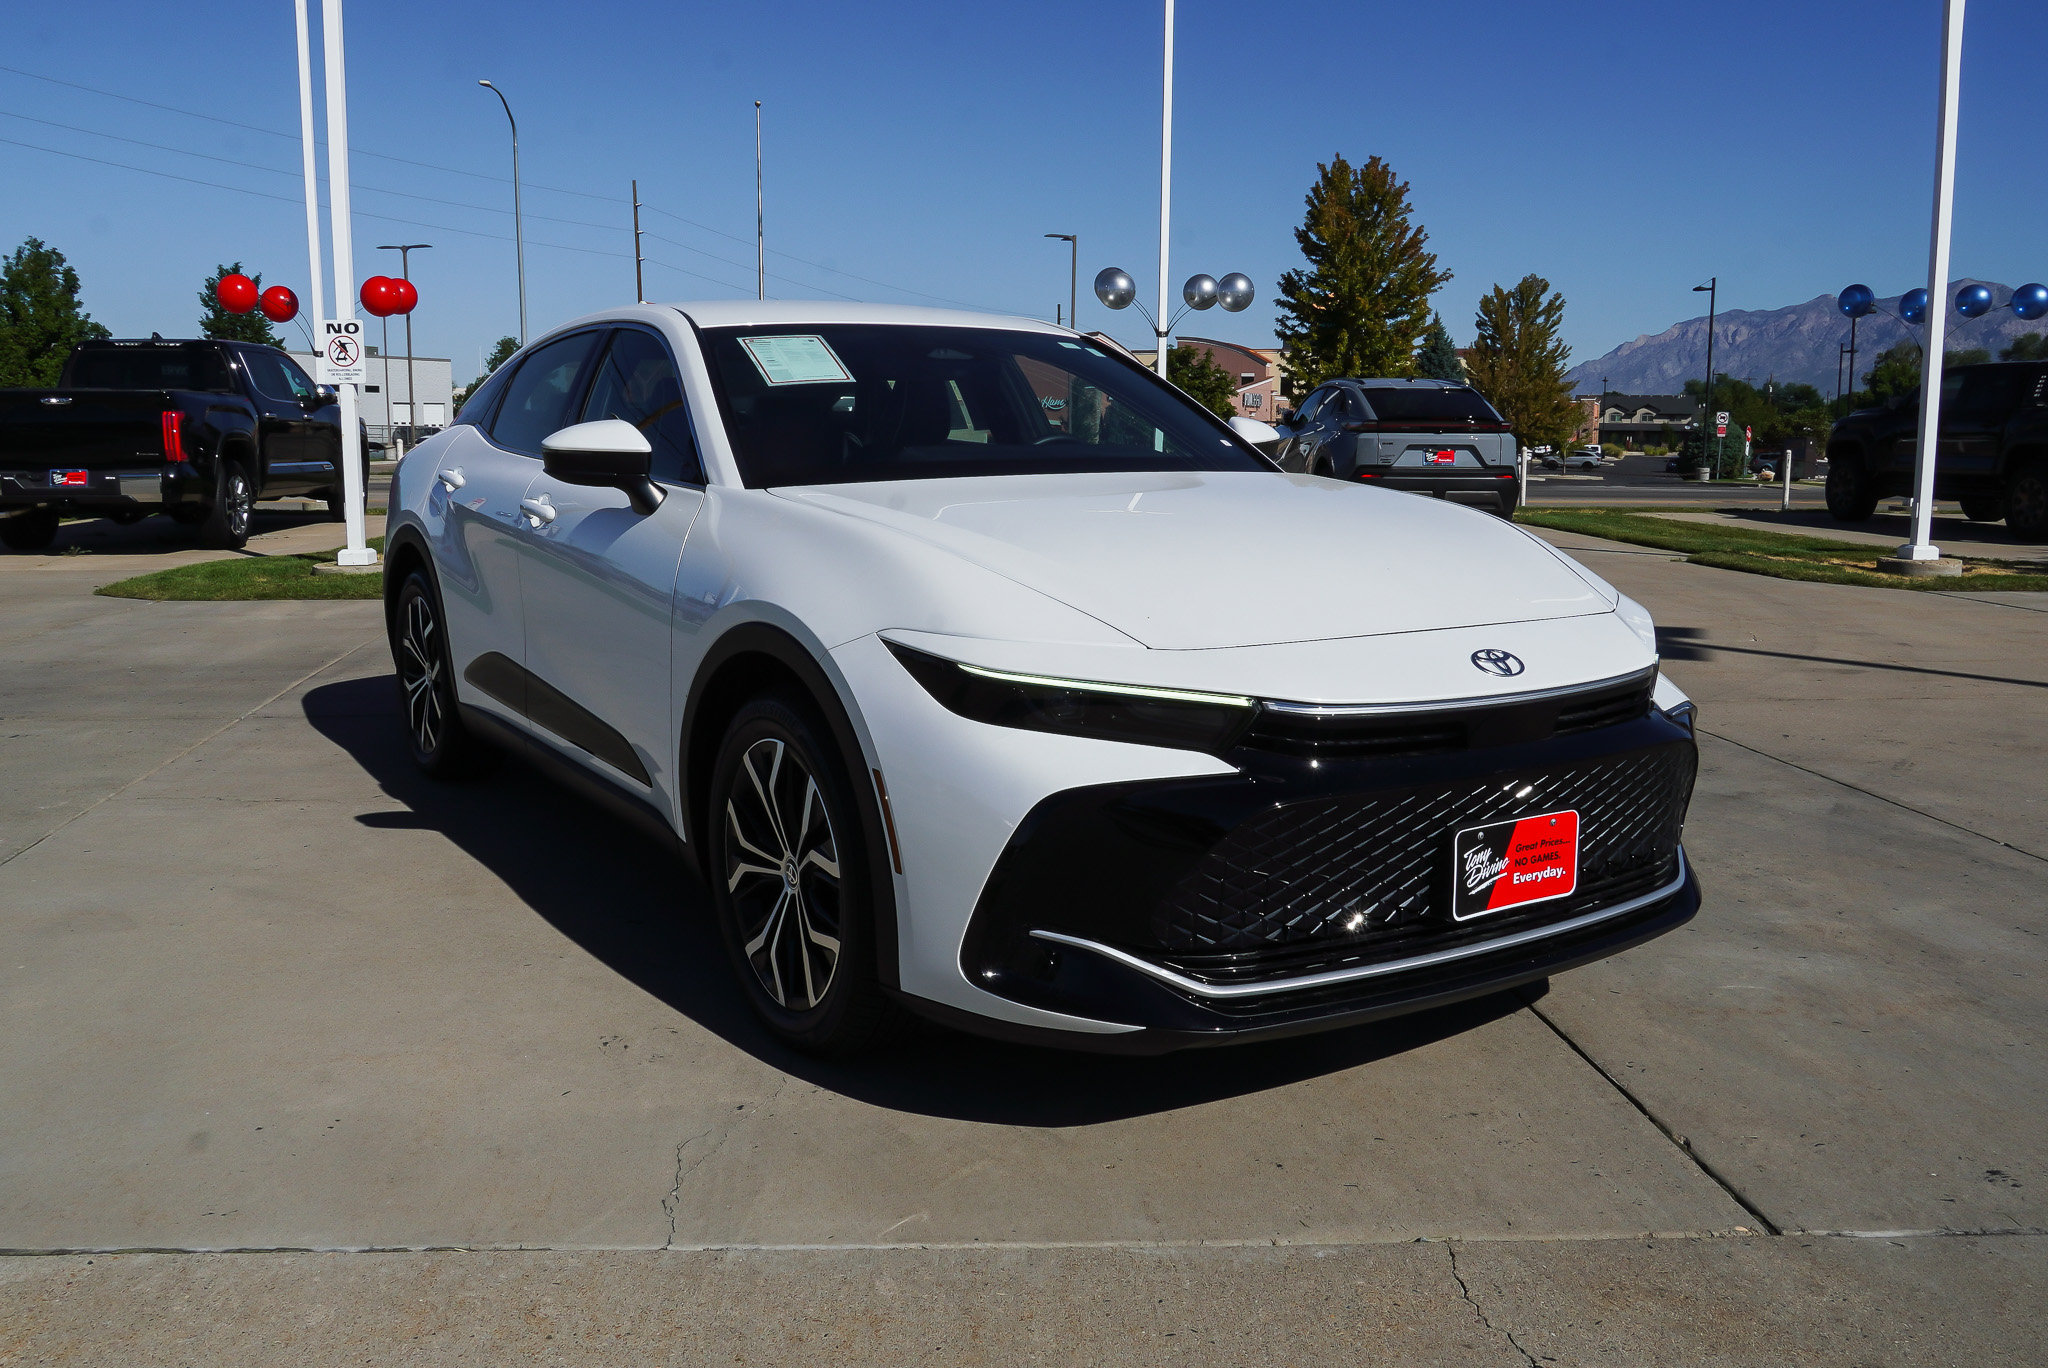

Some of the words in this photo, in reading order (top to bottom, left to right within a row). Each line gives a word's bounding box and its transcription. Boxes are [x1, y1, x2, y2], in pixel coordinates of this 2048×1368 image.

[326, 322, 360, 334] NO
[1515, 842, 1538, 853] Great
[1463, 843, 1493, 871] Tony
[1514, 857, 1529, 867] NO
[1530, 851, 1562, 864] GAMES.
[1513, 866, 1567, 885] Everyday.
